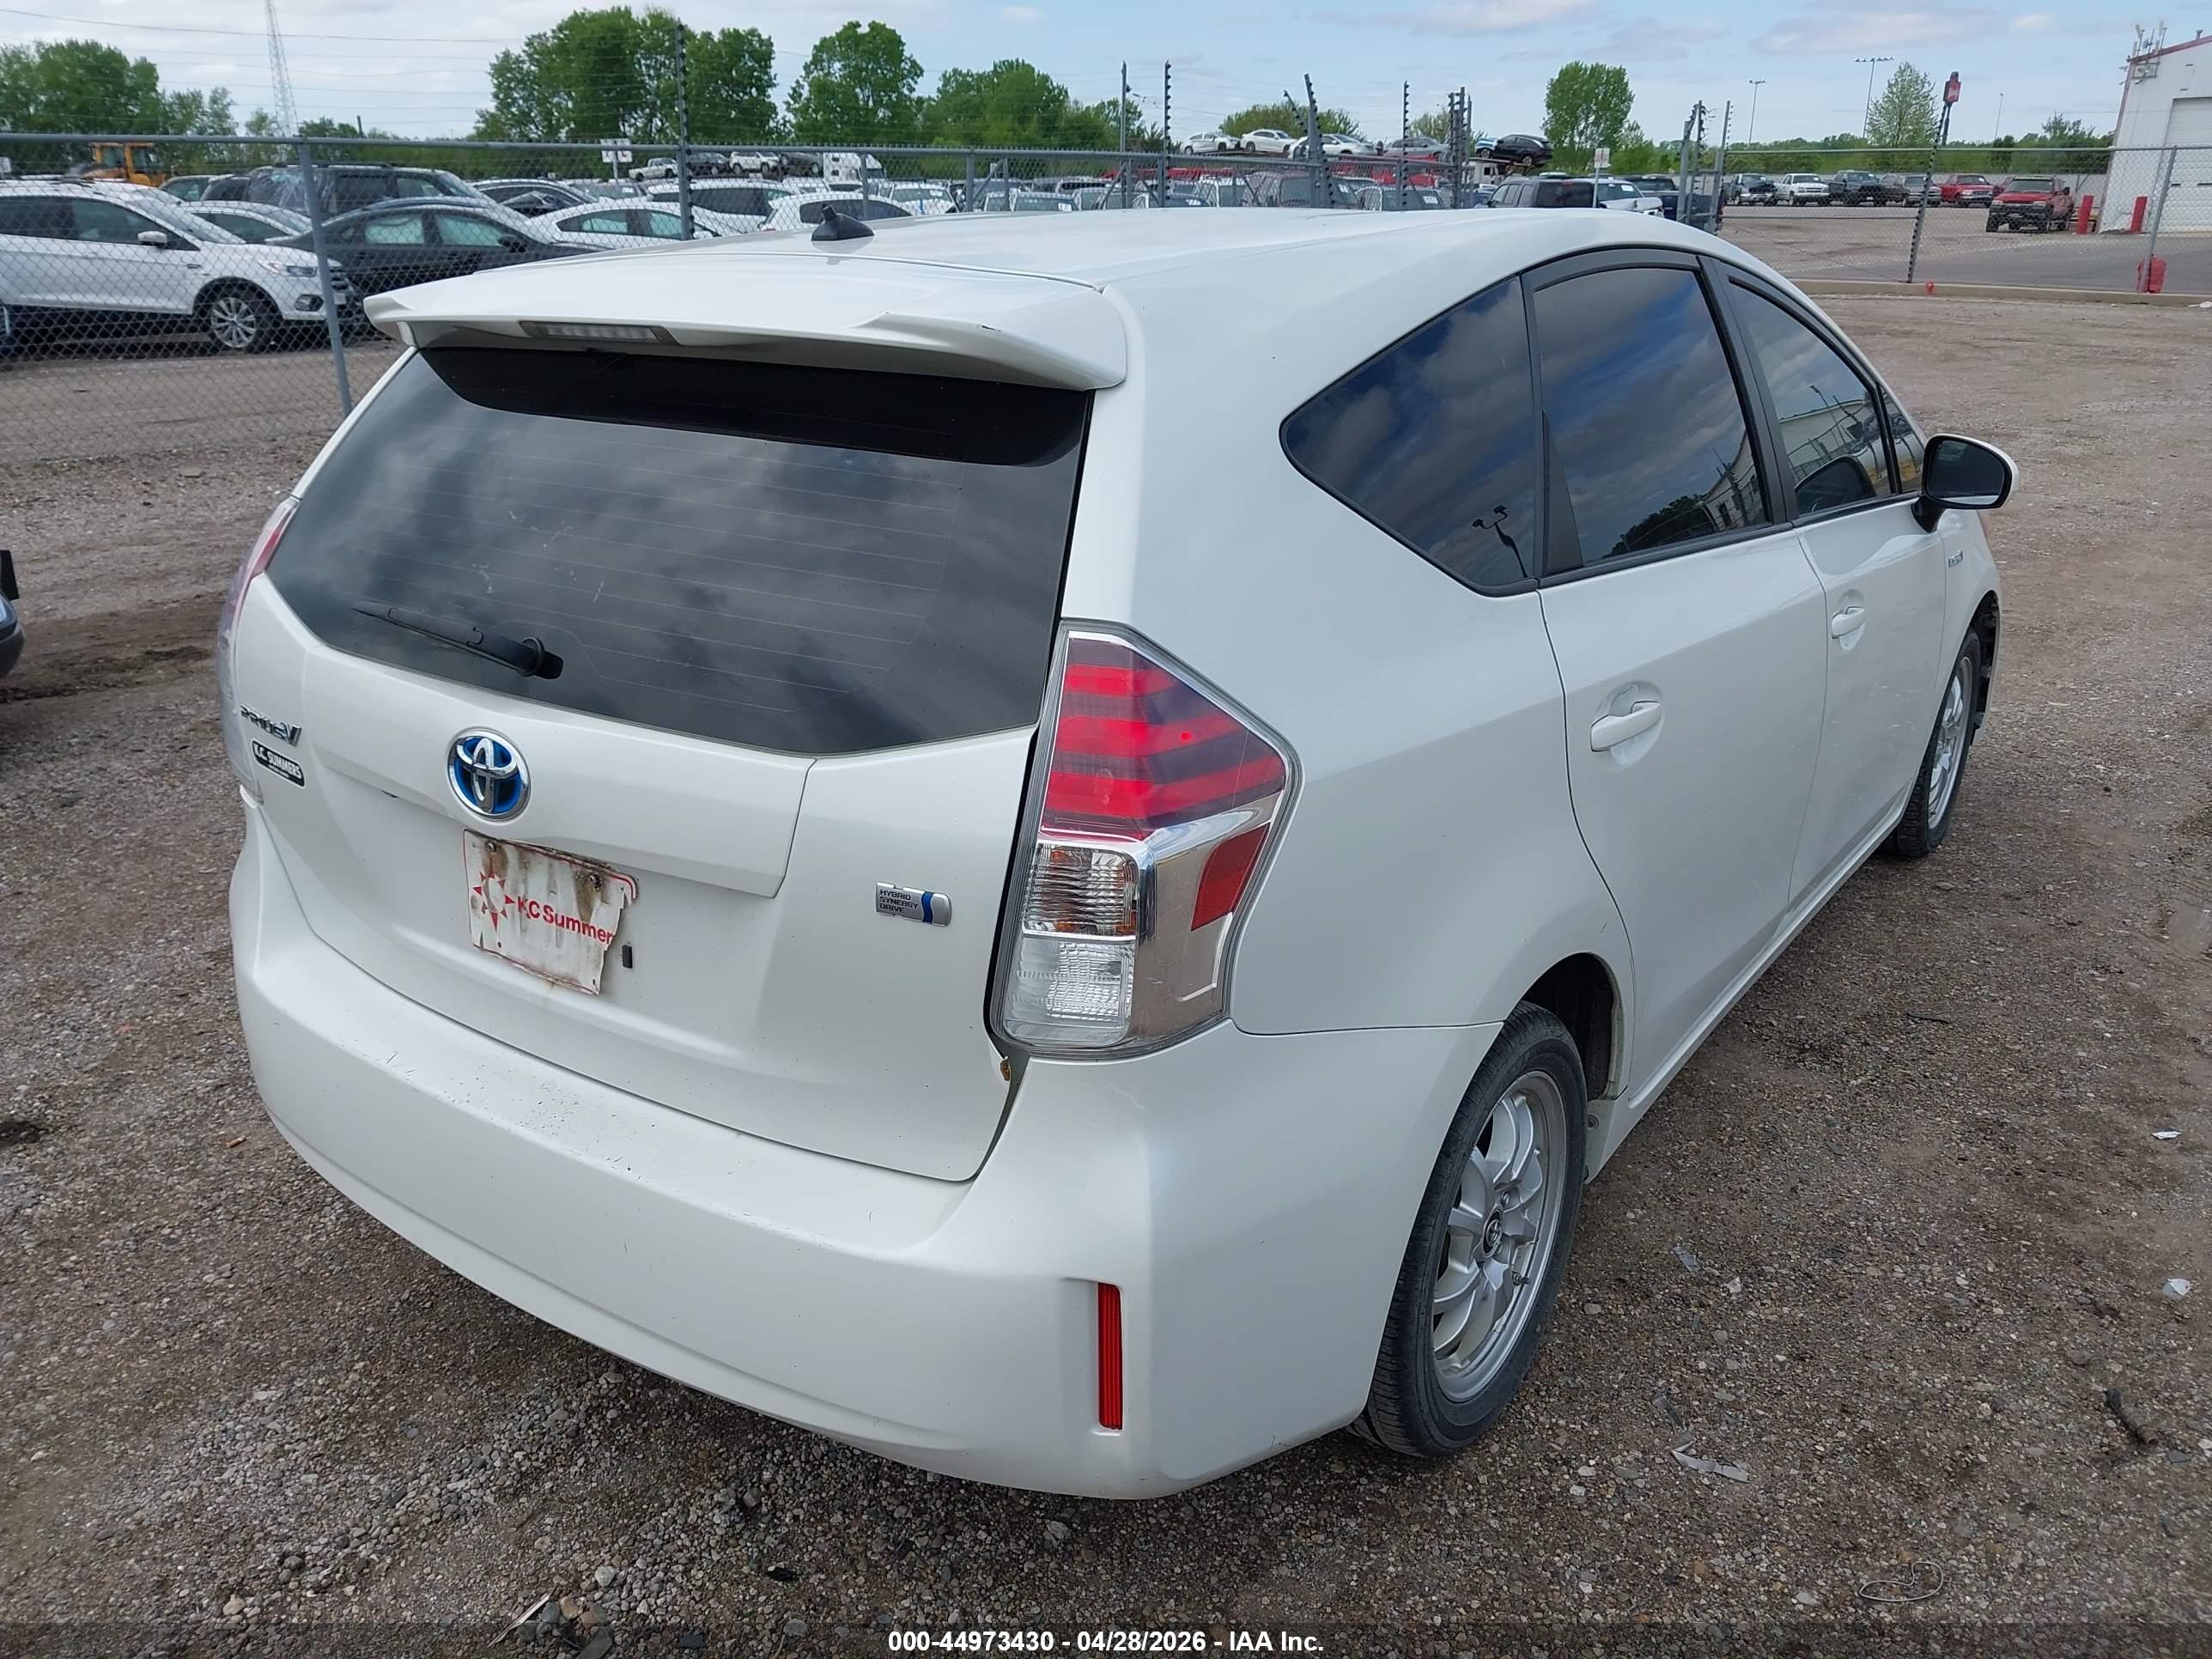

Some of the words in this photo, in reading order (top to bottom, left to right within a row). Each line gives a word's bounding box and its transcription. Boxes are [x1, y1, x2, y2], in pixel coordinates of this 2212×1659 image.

[266, 750, 302, 780] SUMMERS
[879, 889, 911, 901] HYBRID
[517, 896, 541, 919] KC
[879, 896, 918, 909] SYNERGY
[879, 902, 905, 914] DRIVE
